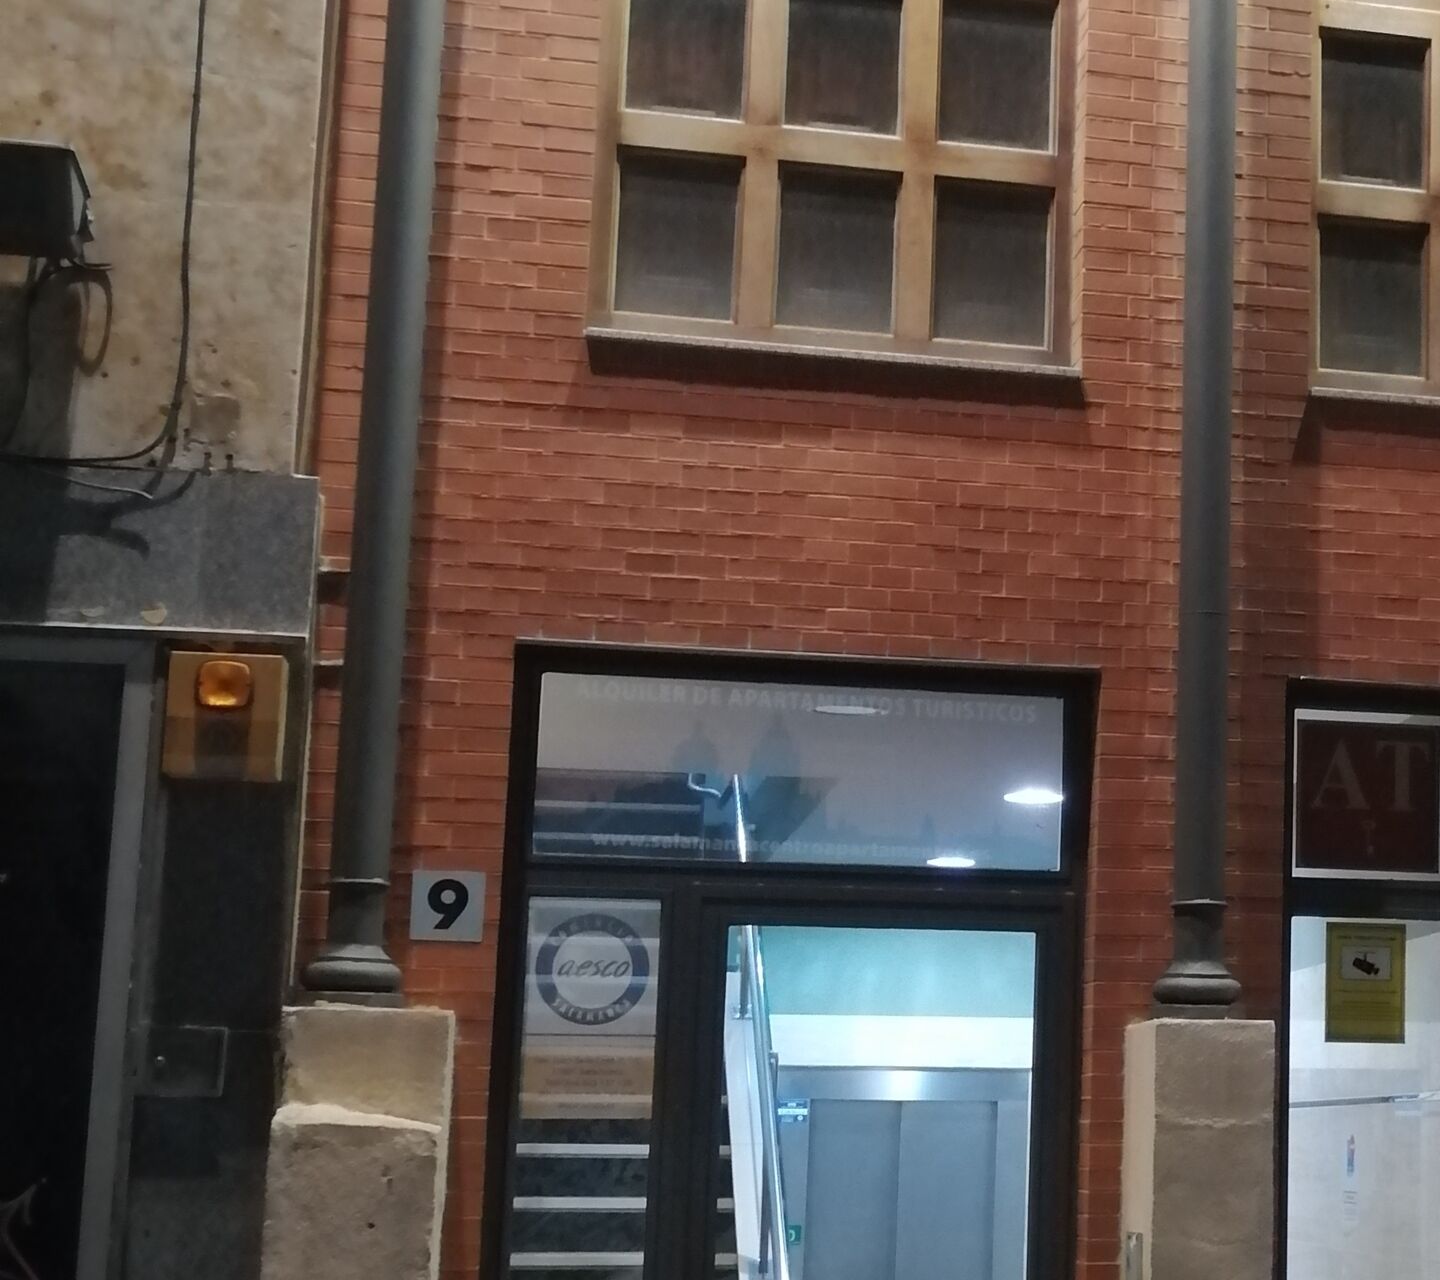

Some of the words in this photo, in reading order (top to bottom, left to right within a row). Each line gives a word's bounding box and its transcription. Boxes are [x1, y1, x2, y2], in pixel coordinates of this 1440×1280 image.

[577, 681, 688, 704] ALQUILER
[693, 686, 722, 706] DE
[1313, 739, 1430, 811] AT
[427, 878, 470, 930] 9
[557, 959, 631, 978] aesco
